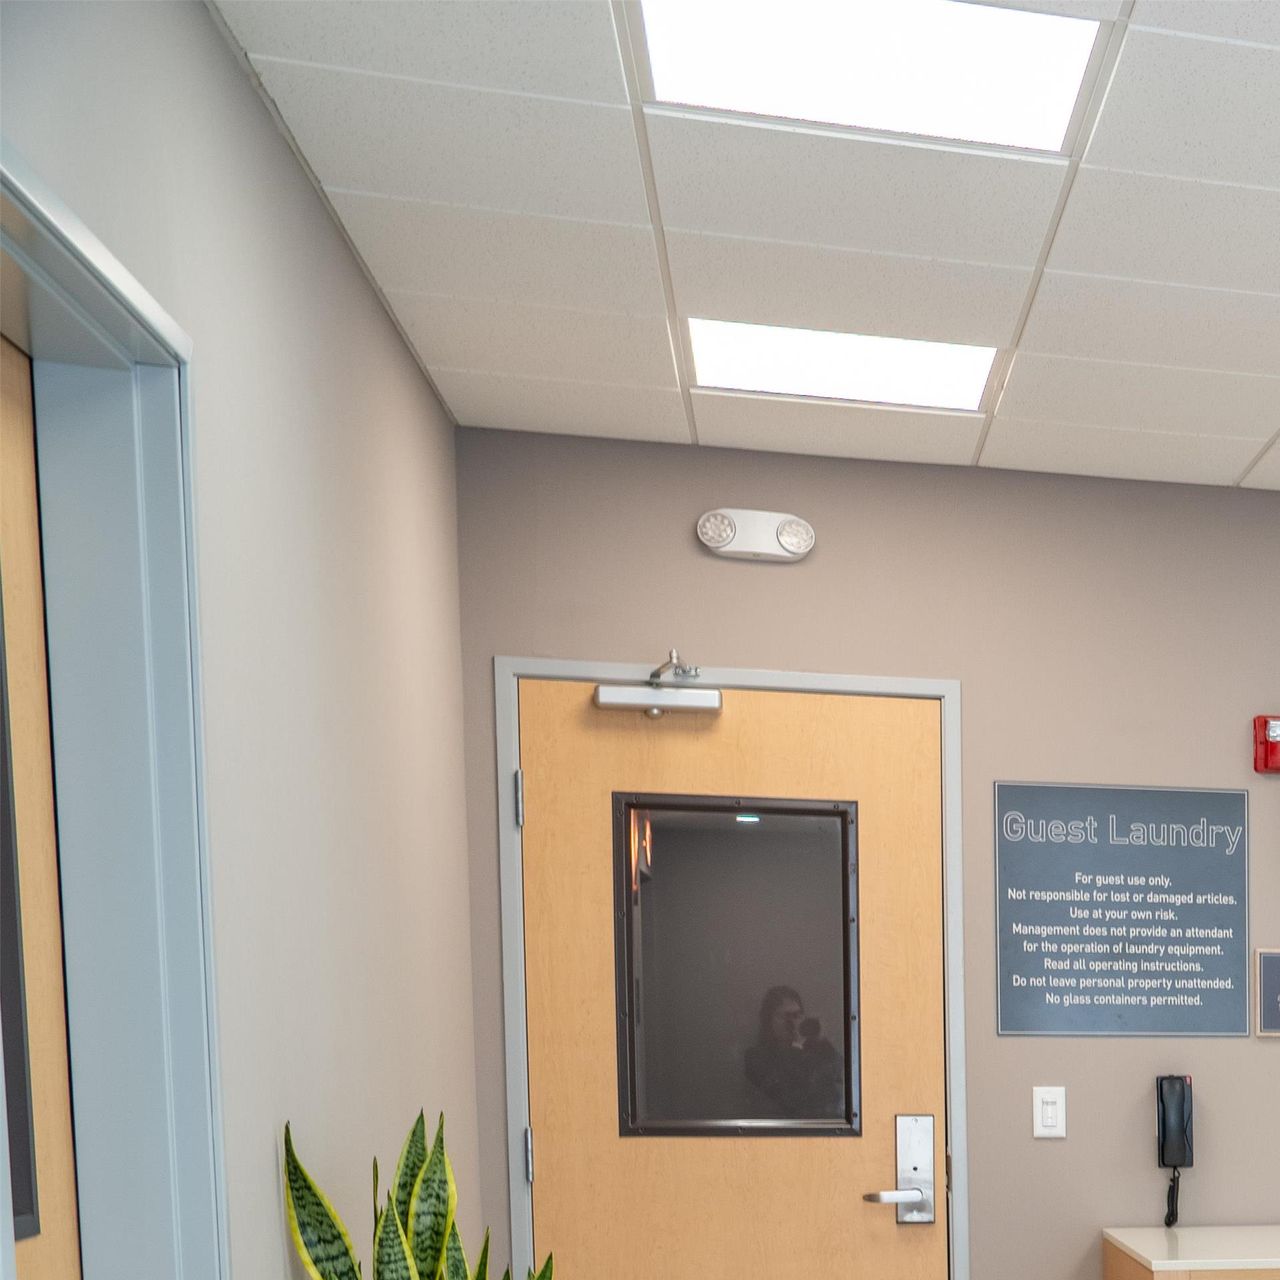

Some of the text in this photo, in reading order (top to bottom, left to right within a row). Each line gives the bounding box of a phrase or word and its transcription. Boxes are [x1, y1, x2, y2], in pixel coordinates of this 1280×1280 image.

[1002, 810, 1242, 854] Guest Laundry
[1075, 871, 1171, 888] For guest use only.
[1007, 887, 1236, 906] Not responsible for lost or damaged articles.
[1069, 906, 1177, 921] Use at your own risk.
[1012, 922, 1233, 939] Management does not provide an attendant
[1023, 940, 1223, 957] for the operation of laundry equipment.
[1044, 957, 1203, 973] Read all operating instructions.
[1012, 974, 1233, 990] Do not leave personal property unattended.
[1045, 992, 1202, 1007] No glass containers permitted.
